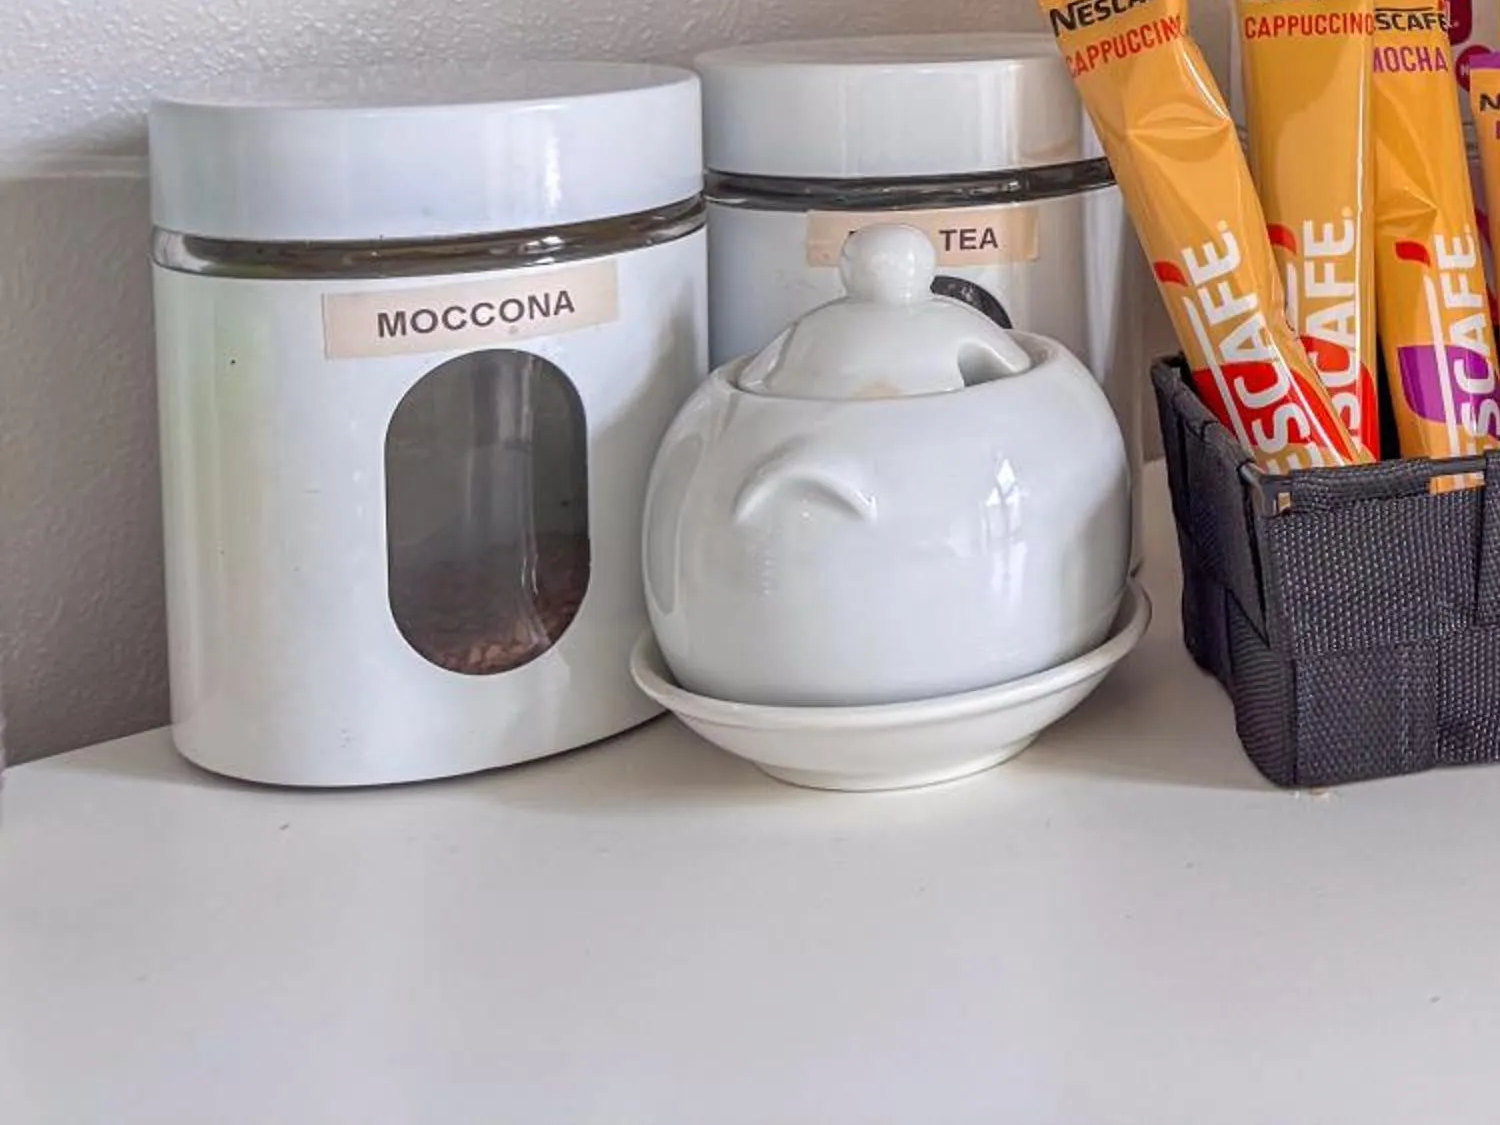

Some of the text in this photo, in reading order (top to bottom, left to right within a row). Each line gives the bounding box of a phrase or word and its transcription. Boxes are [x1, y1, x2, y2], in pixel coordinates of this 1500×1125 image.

[1065, 15, 1183, 78] CAPPUCCIN
[938, 227, 998, 252] TEA
[376, 290, 576, 339] MOCCONA
